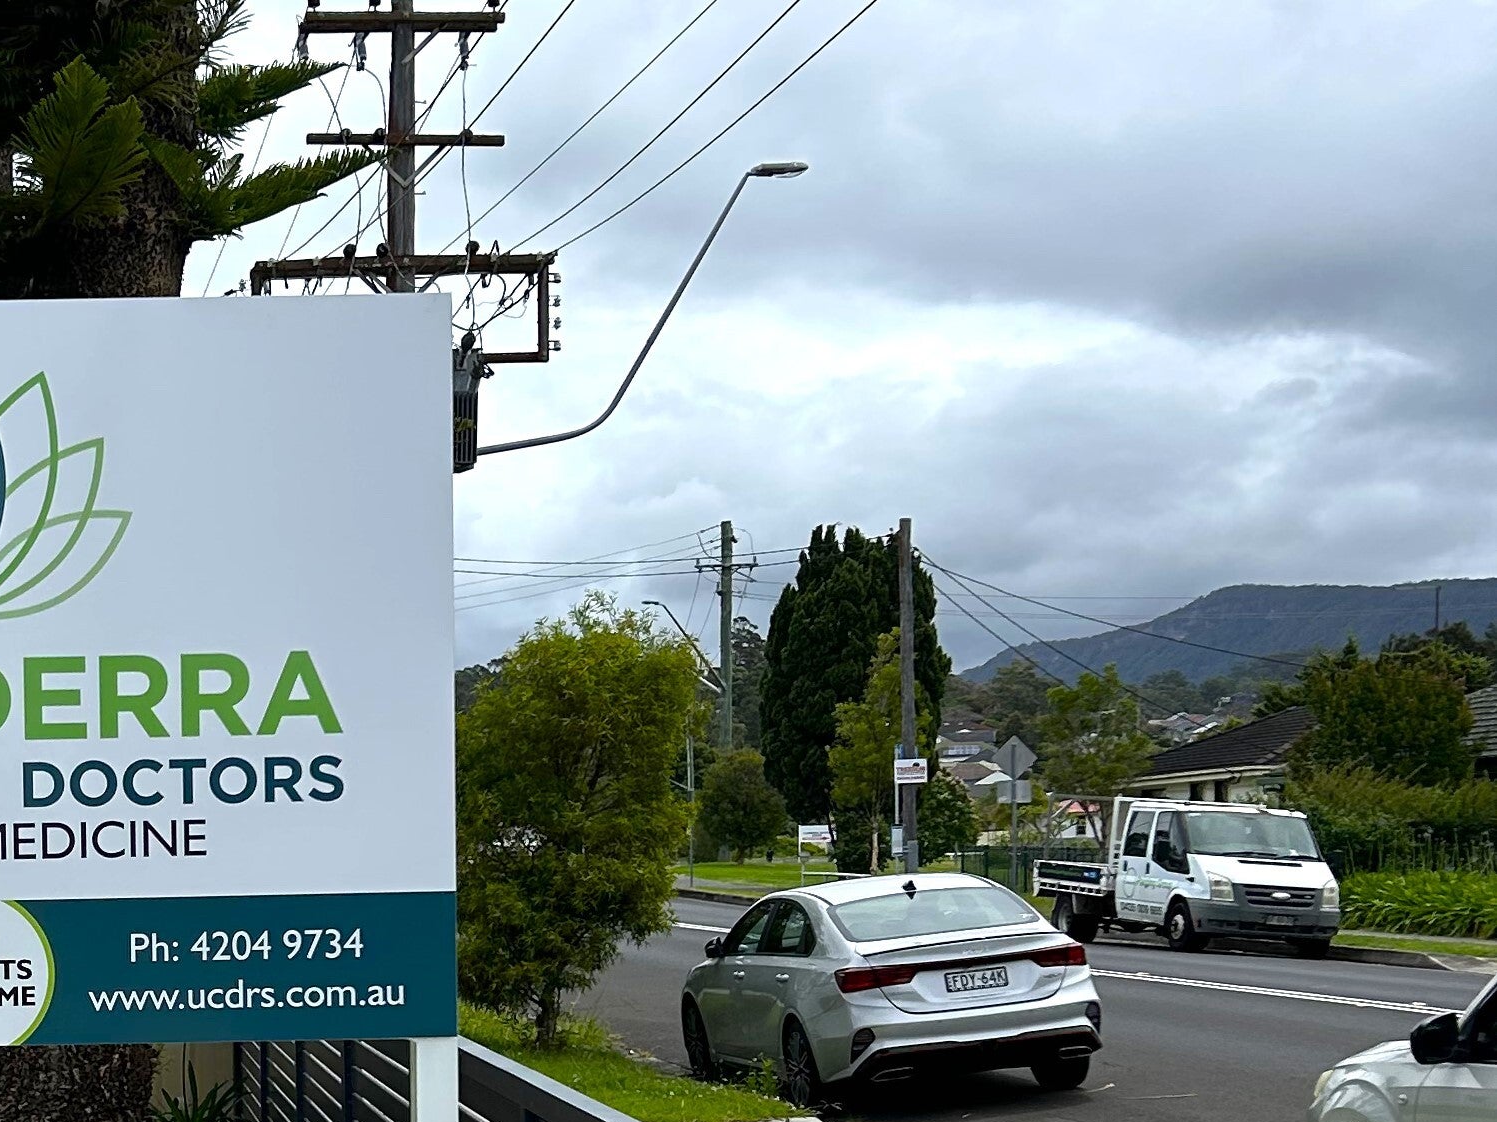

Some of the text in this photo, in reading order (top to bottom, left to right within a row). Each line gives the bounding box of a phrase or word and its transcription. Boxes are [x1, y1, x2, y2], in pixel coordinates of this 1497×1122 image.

[23, 755, 344, 808] DOCTORS
[130, 928, 364, 963] Ph: 4204 9734
[88, 979, 405, 1012] www.ucdrs.com.au
